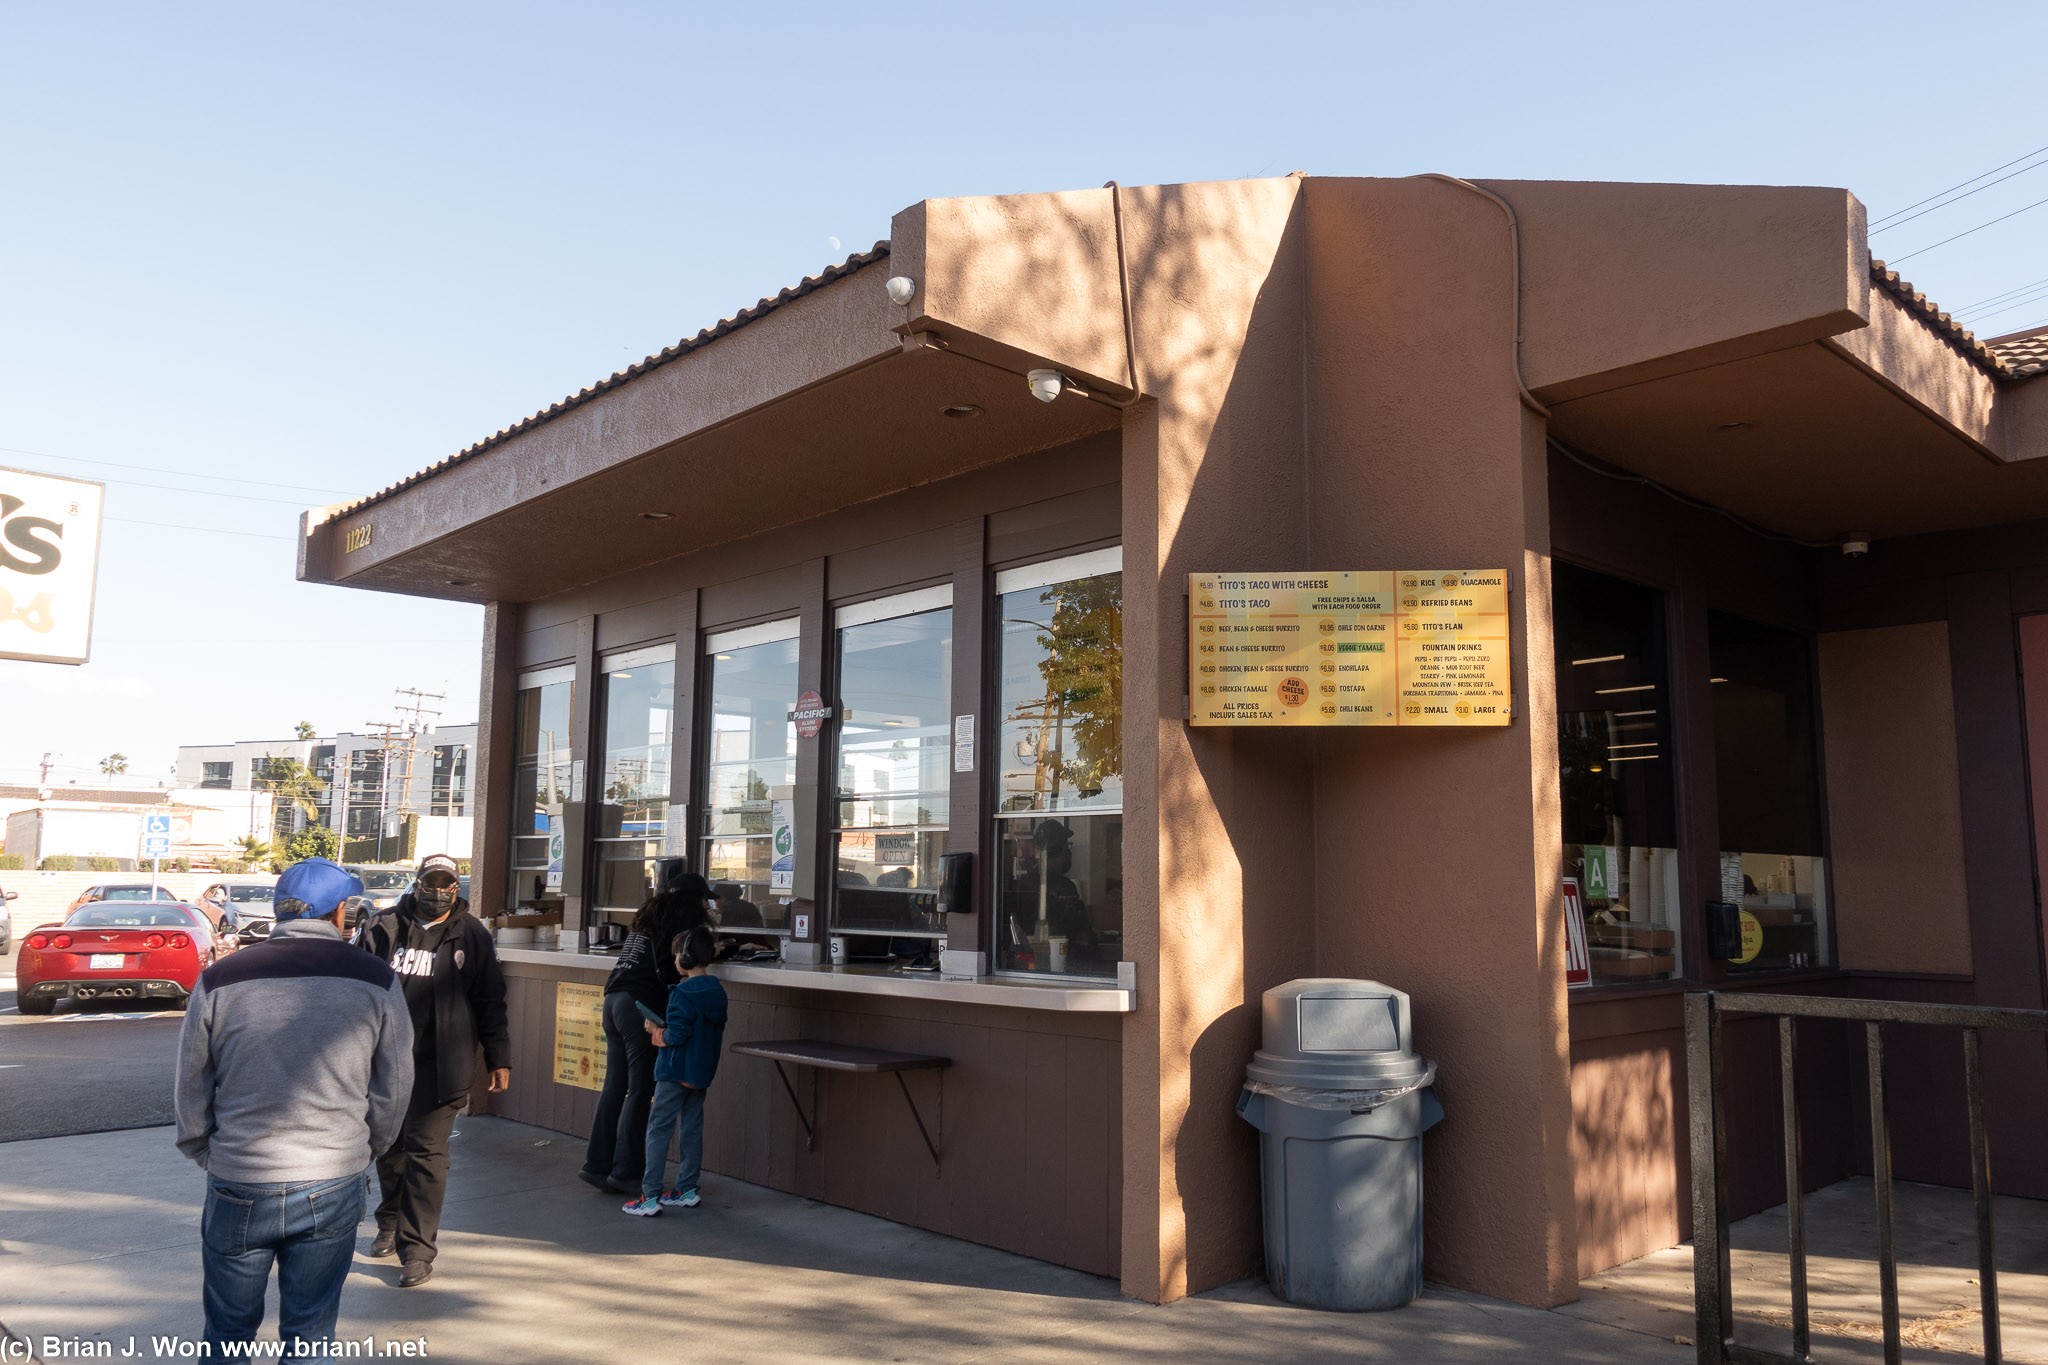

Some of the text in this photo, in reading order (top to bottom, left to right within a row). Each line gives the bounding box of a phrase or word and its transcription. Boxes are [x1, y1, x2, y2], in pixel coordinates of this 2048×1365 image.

[345, 523, 372, 554] 11222
[1219, 580, 1246, 589] TITO'S
[1248, 580, 1270, 589] TACO
[1272, 580, 1295, 589] WITH
[1297, 580, 1329, 589] CHEESE
[1460, 578, 1502, 586] GUACAMOLE
[1219, 599, 1246, 608] TITO'S
[1248, 599, 1270, 608] TACO
[1282, 686, 1304, 695] CHEESE
[794, 709, 825, 720] PACIFIC
[1424, 706, 1448, 714] SMALL
[1474, 706, 1496, 714] LARGE
[878, 838, 910, 848] WINDOW
[883, 851, 906, 862] OPEN
[1590, 858, 1604, 886] A
[831, 942, 838, 953] S
